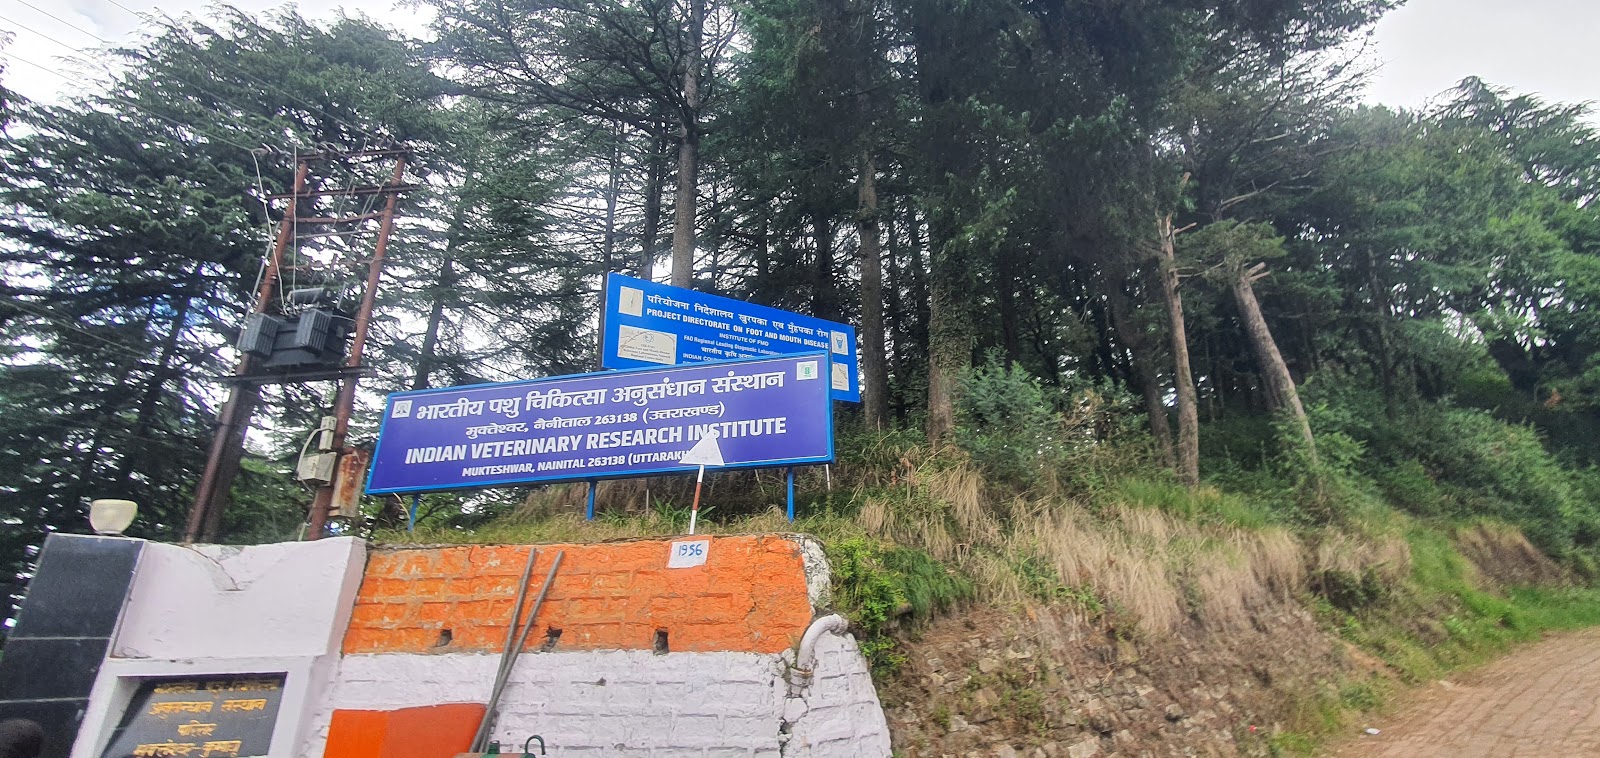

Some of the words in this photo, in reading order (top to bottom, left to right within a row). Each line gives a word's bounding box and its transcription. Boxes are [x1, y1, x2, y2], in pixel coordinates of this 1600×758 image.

[646, 308, 681, 321] PROJECT
[682, 315, 730, 331] DIRECTORATE
[733, 324, 743, 333] ON
[745, 327, 763, 337] FOOT
[764, 331, 778, 340] AND
[779, 334, 802, 345] MOUTH
[803, 338, 829, 349] DISEASE
[647, 294, 690, 311] परियोजना
[694, 302, 734, 320] निदेशालय
[816, 328, 829, 339] रोग
[694, 336, 716, 346] Regional
[715, 341, 734, 349] Leading
[734, 344, 757, 353] Diagnostic
[719, 332, 748, 343] INSTITUTE
[683, 353, 702, 361] INDIAN
[416, 397, 486, 420] भारतीय
[490, 396, 522, 418] पशु
[525, 388, 608, 412] चिकित्सा
[611, 376, 708, 407] अनुसंधान
[711, 370, 786, 394] संस्थान
[466, 422, 529, 439] मुक्तेश्वर,
[533, 415, 593, 430] नैनीताल
[594, 412, 638, 426] 263138
[642, 401, 726, 425] (उत्तराखण्ड)
[405, 446, 466, 464] INDIAN
[470, 434, 583, 460] VETERINARY
[586, 426, 683, 450] RESEARCH
[687, 417, 787, 441] INSTITUTE
[462, 462, 536, 477] MUKTESHWAR,
[537, 459, 586, 472] NAINITAL
[587, 455, 626, 468] 263138
[678, 543, 703, 557] 1956
